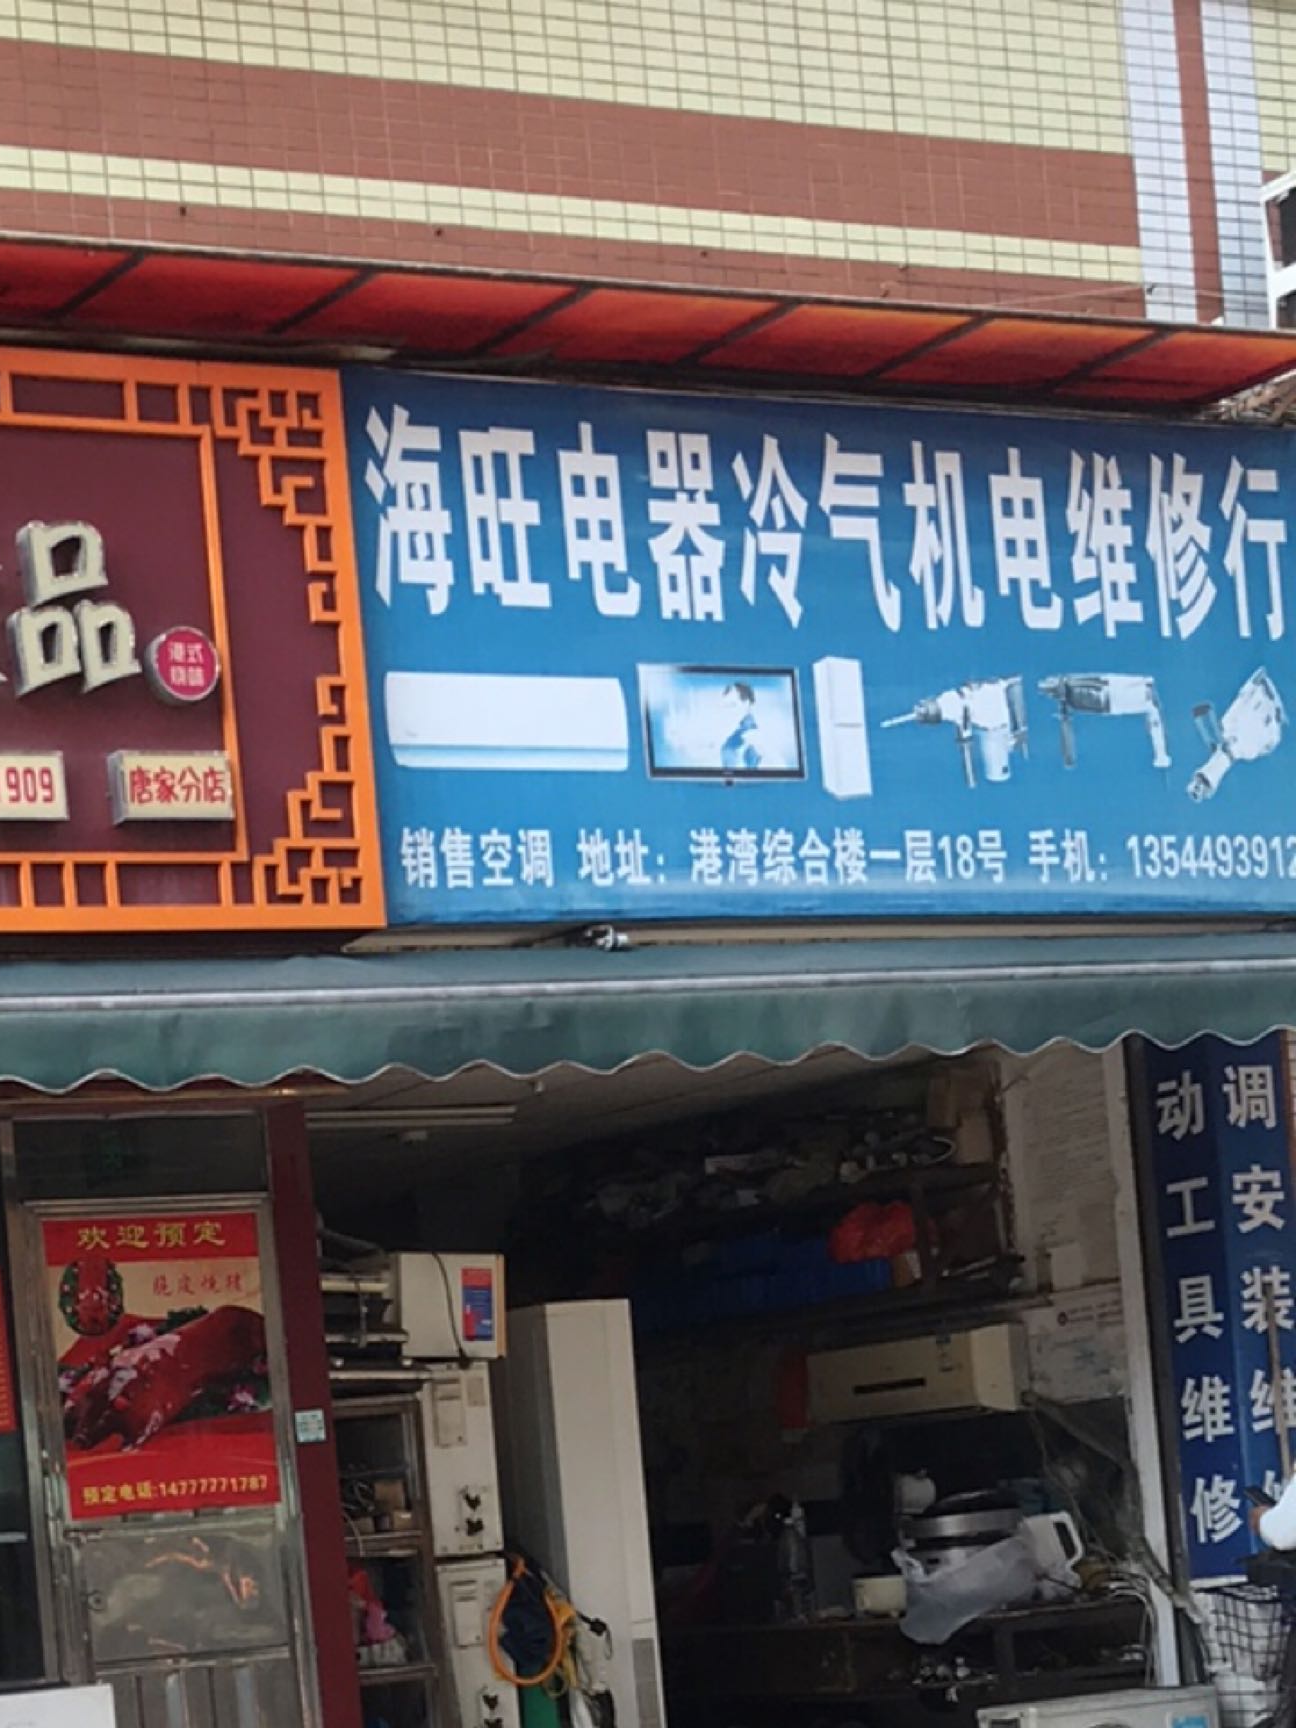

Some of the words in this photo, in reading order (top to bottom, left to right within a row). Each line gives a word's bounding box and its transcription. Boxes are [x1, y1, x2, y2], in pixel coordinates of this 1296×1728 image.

[364, 403, 1287, 641] 海旺电器冷气机电维修行
[129, 765, 227, 806] 唐家分店
[401, 827, 555, 888] 销售空调
[689, 827, 1007, 886] 港湾综合楼一层18号
[77, 1221, 226, 1250] 欢迎预定
